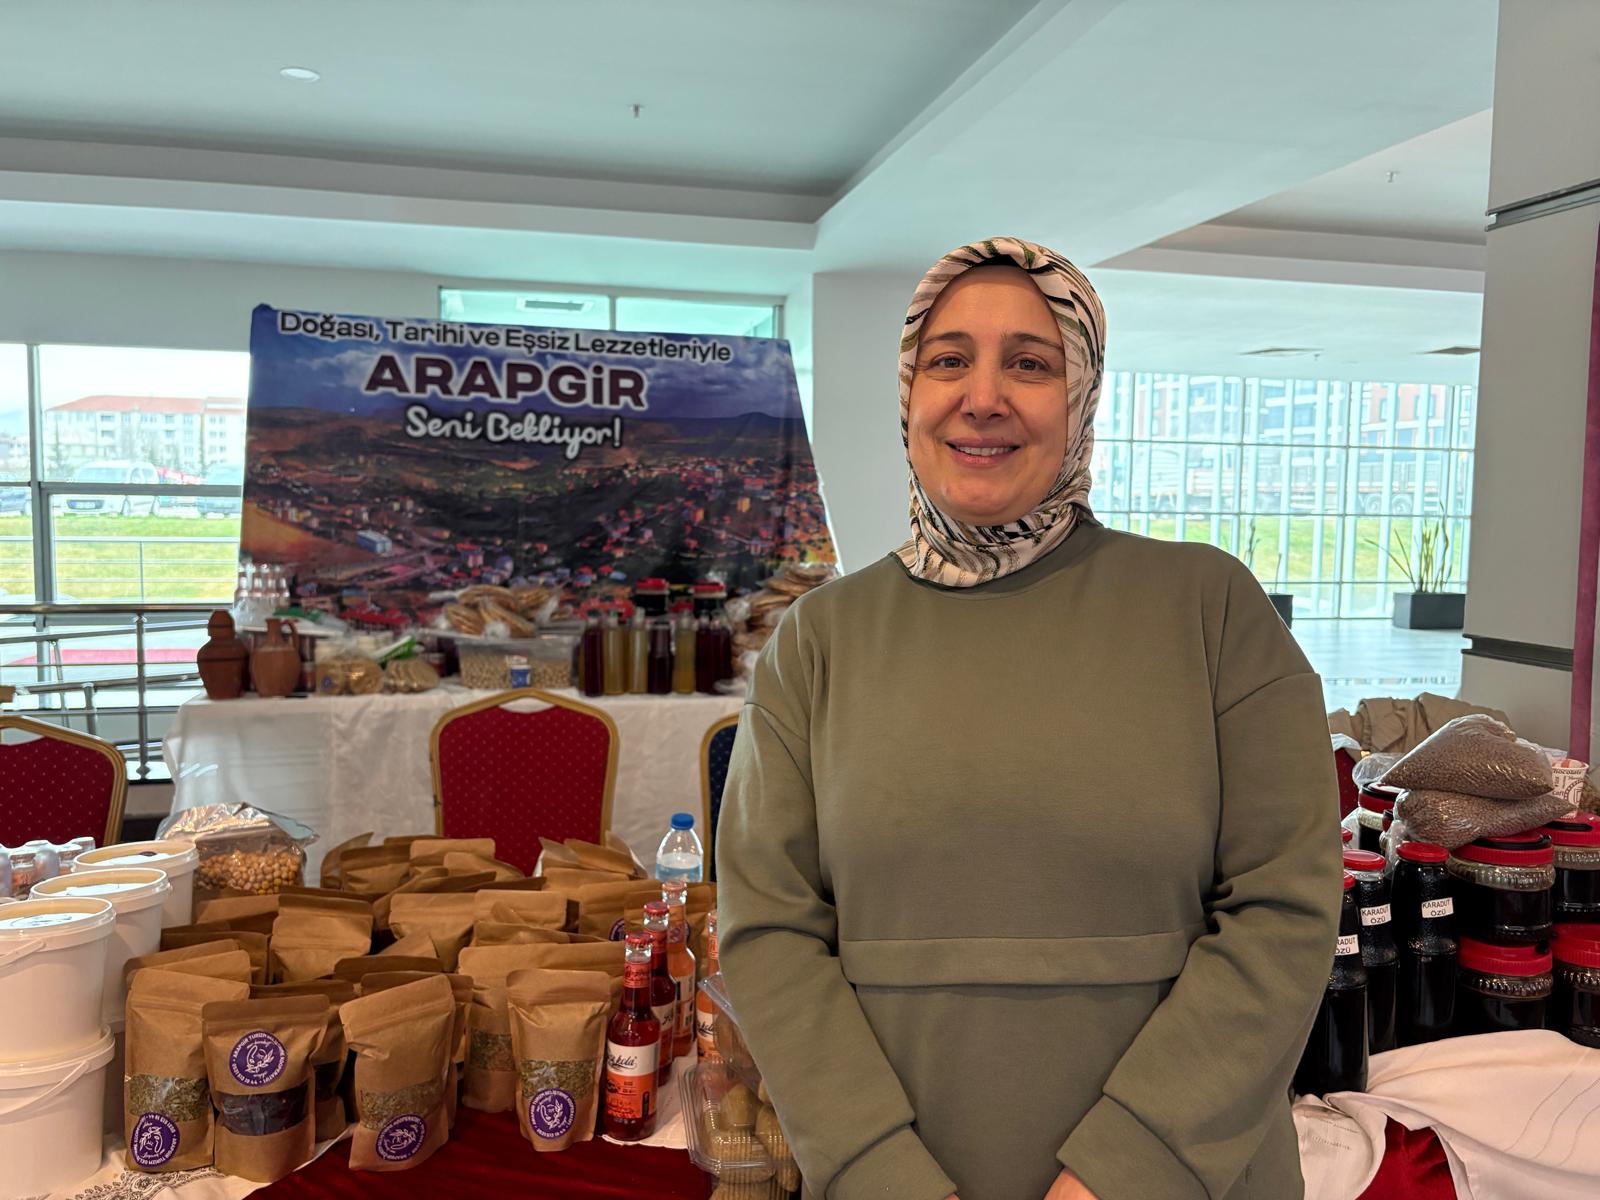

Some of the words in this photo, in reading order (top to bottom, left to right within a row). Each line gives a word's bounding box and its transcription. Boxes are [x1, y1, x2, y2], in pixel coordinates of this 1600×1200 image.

[279, 311, 381, 342] Doğası,
[385, 320, 464, 345] Tarihi
[469, 328, 499, 346] ve
[505, 328, 570, 355] Eşsiz
[575, 333, 731, 363] Lezzetleriyle
[405, 405, 482, 438] Seni
[486, 412, 621, 460] Bekliyor!
[1361, 905, 1389, 916] KARADUT
[1422, 899, 1450, 909] KARADUT
